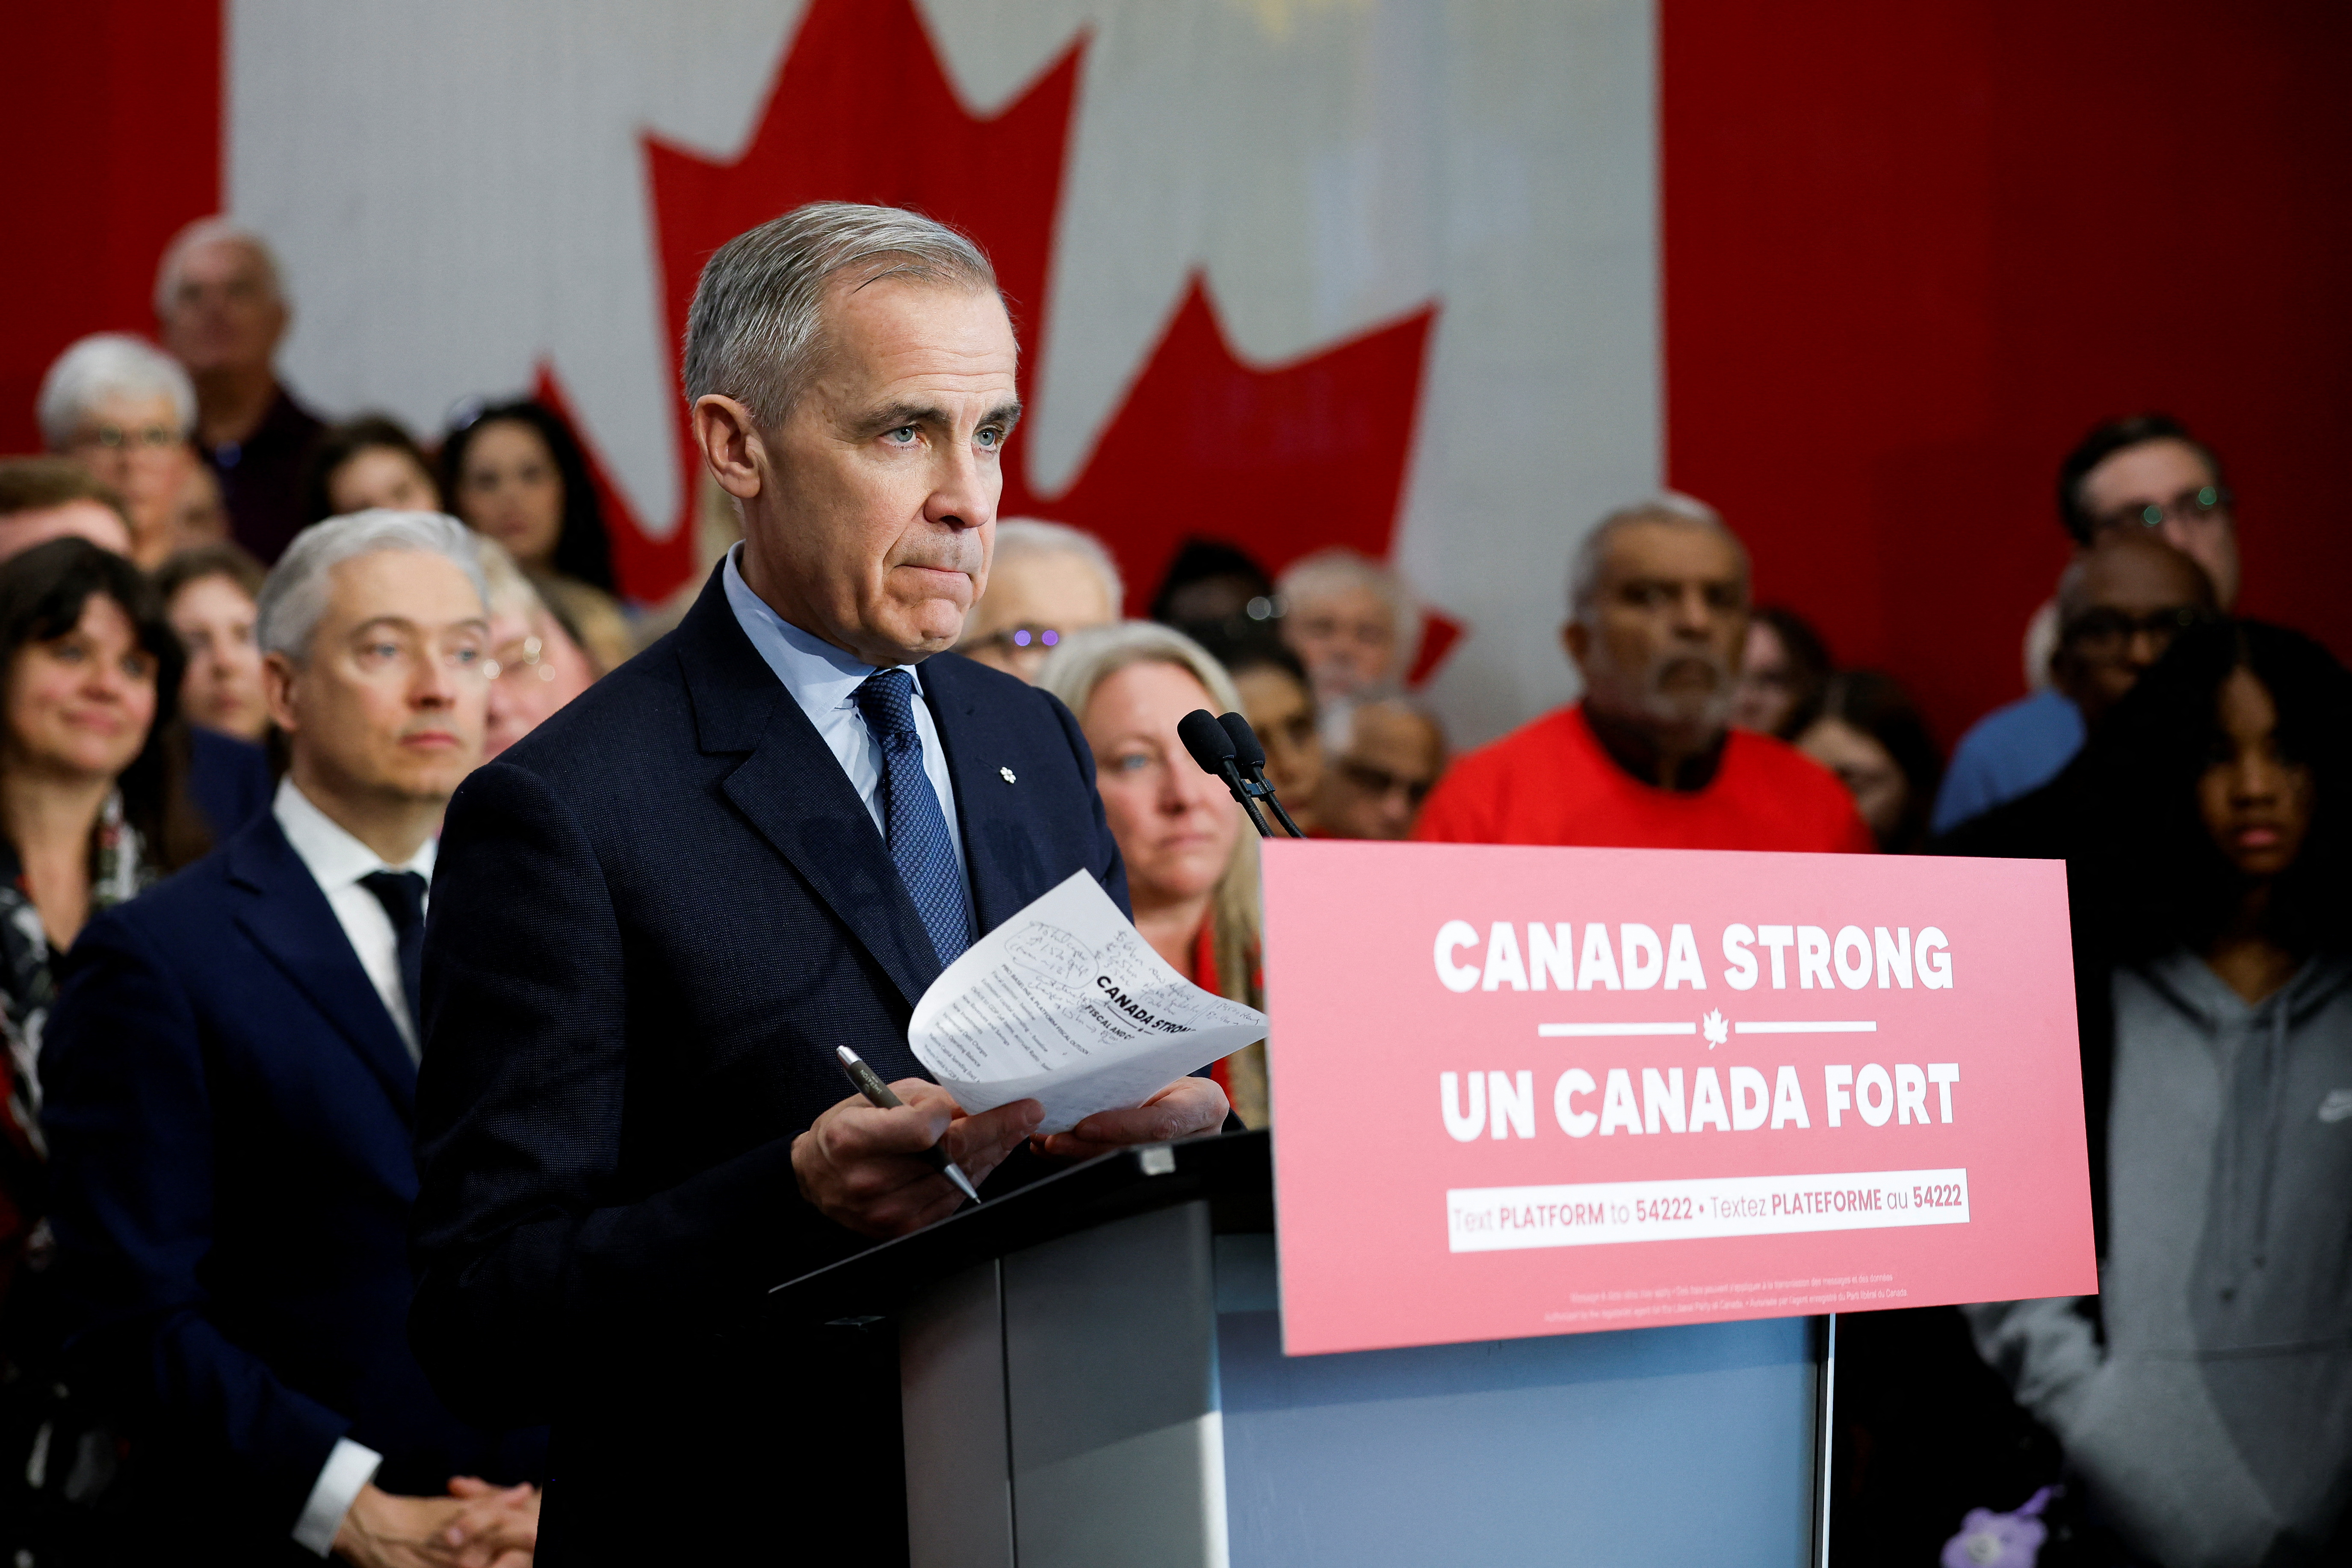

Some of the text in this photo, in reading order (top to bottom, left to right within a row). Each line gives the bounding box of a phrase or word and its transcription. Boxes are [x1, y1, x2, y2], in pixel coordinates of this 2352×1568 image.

[1434, 920, 1953, 992] CANADA STRONG
[1011, 974, 1031, 996] BASELINE
[1034, 1001, 1057, 1027] PLATFORM
[1056, 1026, 1070, 1041] FISCAL
[1083, 1004, 1111, 1028] FISCAL
[1109, 1027, 1126, 1037] AND
[1096, 975, 1155, 1025] CANADA
[1151, 1019, 1196, 1034] STRON
[1440, 1063, 1960, 1142] UN CANADA FORT
[1454, 1184, 1962, 1232] Text PLATFORM to 54222 Textez PLATEFORME au 54222
[1838, 1292, 1846, 1301] du
[1846, 1291, 1860, 1301] Parti
[1861, 1290, 1877, 1300] libéral
[1878, 1290, 1885, 1298] du
[1885, 1288, 1908, 1298] Canada.
[1859, 1274, 1869, 1283] des
[1869, 1273, 1894, 1282] données
